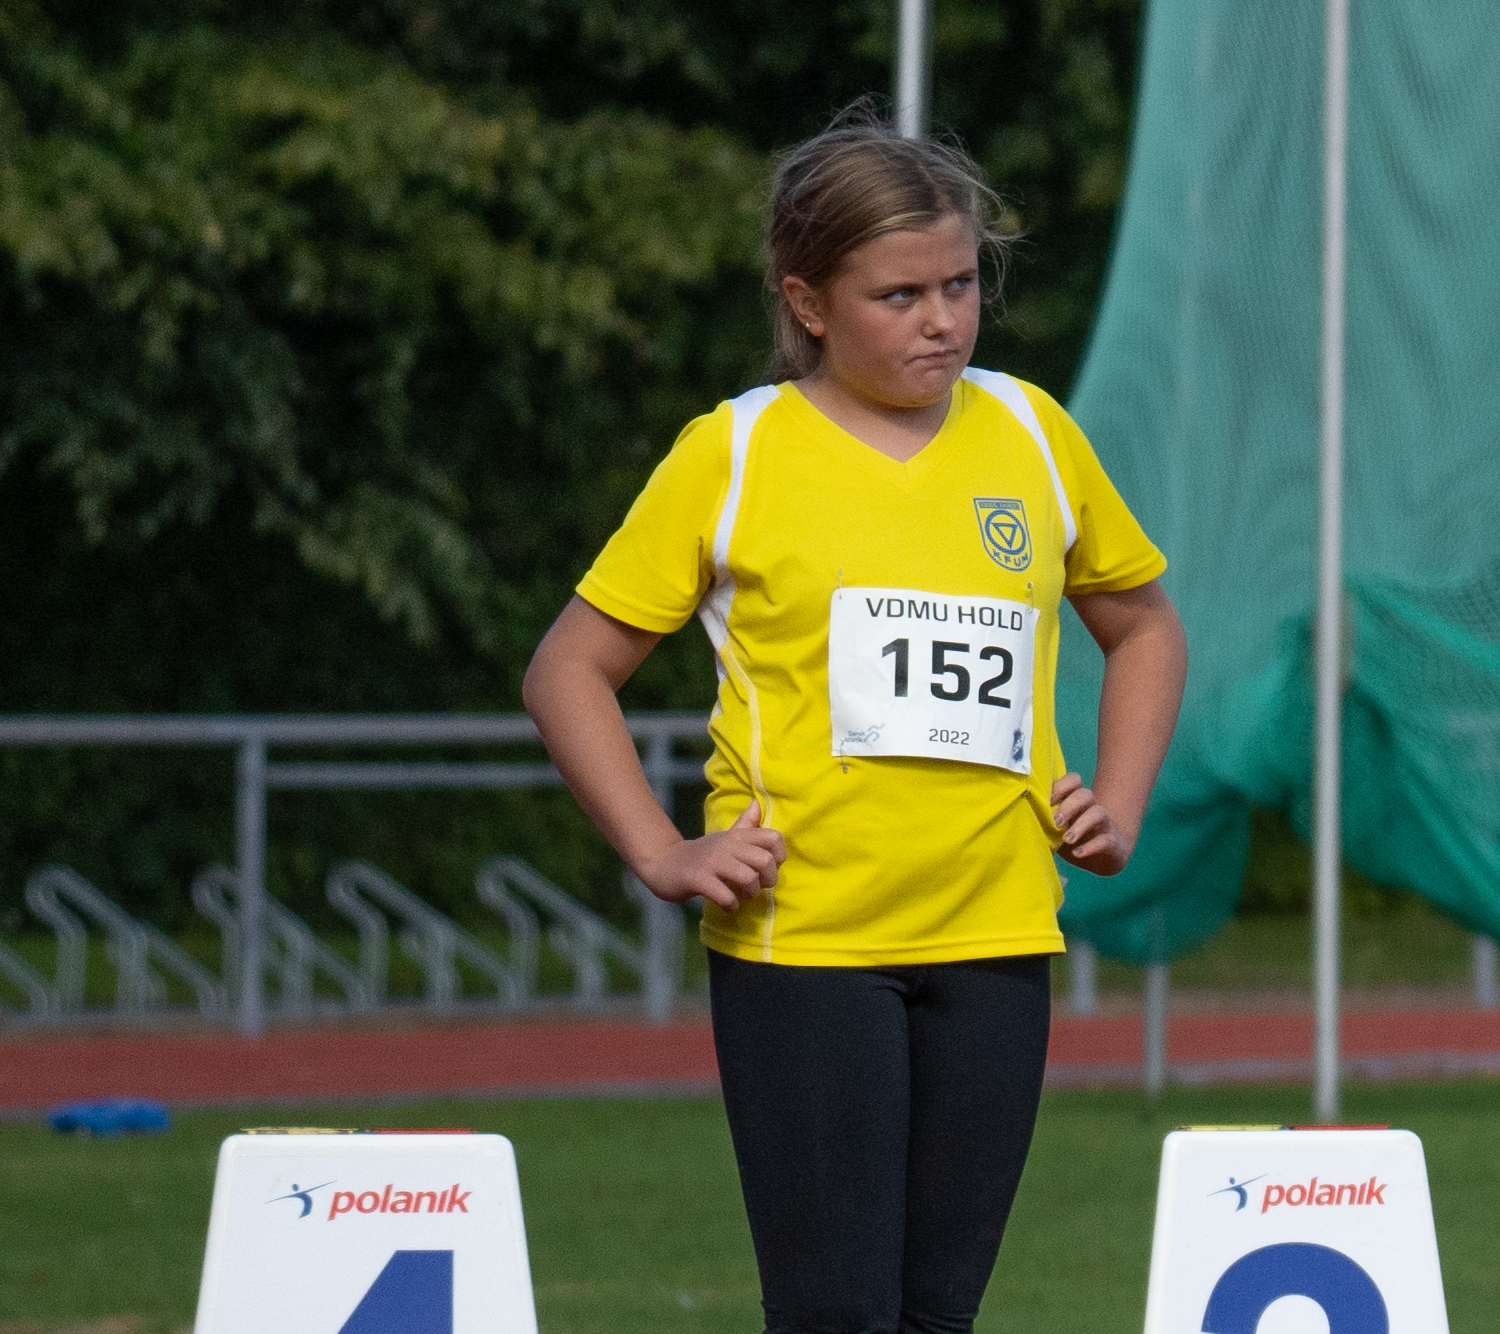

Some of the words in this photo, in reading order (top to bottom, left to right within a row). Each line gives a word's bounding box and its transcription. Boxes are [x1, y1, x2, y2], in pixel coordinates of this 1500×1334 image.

[866, 598, 948, 622] VDMU
[957, 606, 1023, 632] HOLD
[881, 638, 1014, 709] 152
[928, 728, 970, 746] 2022
[327, 1182, 474, 1222] polanik
[1260, 1175, 1387, 1215] polanik
